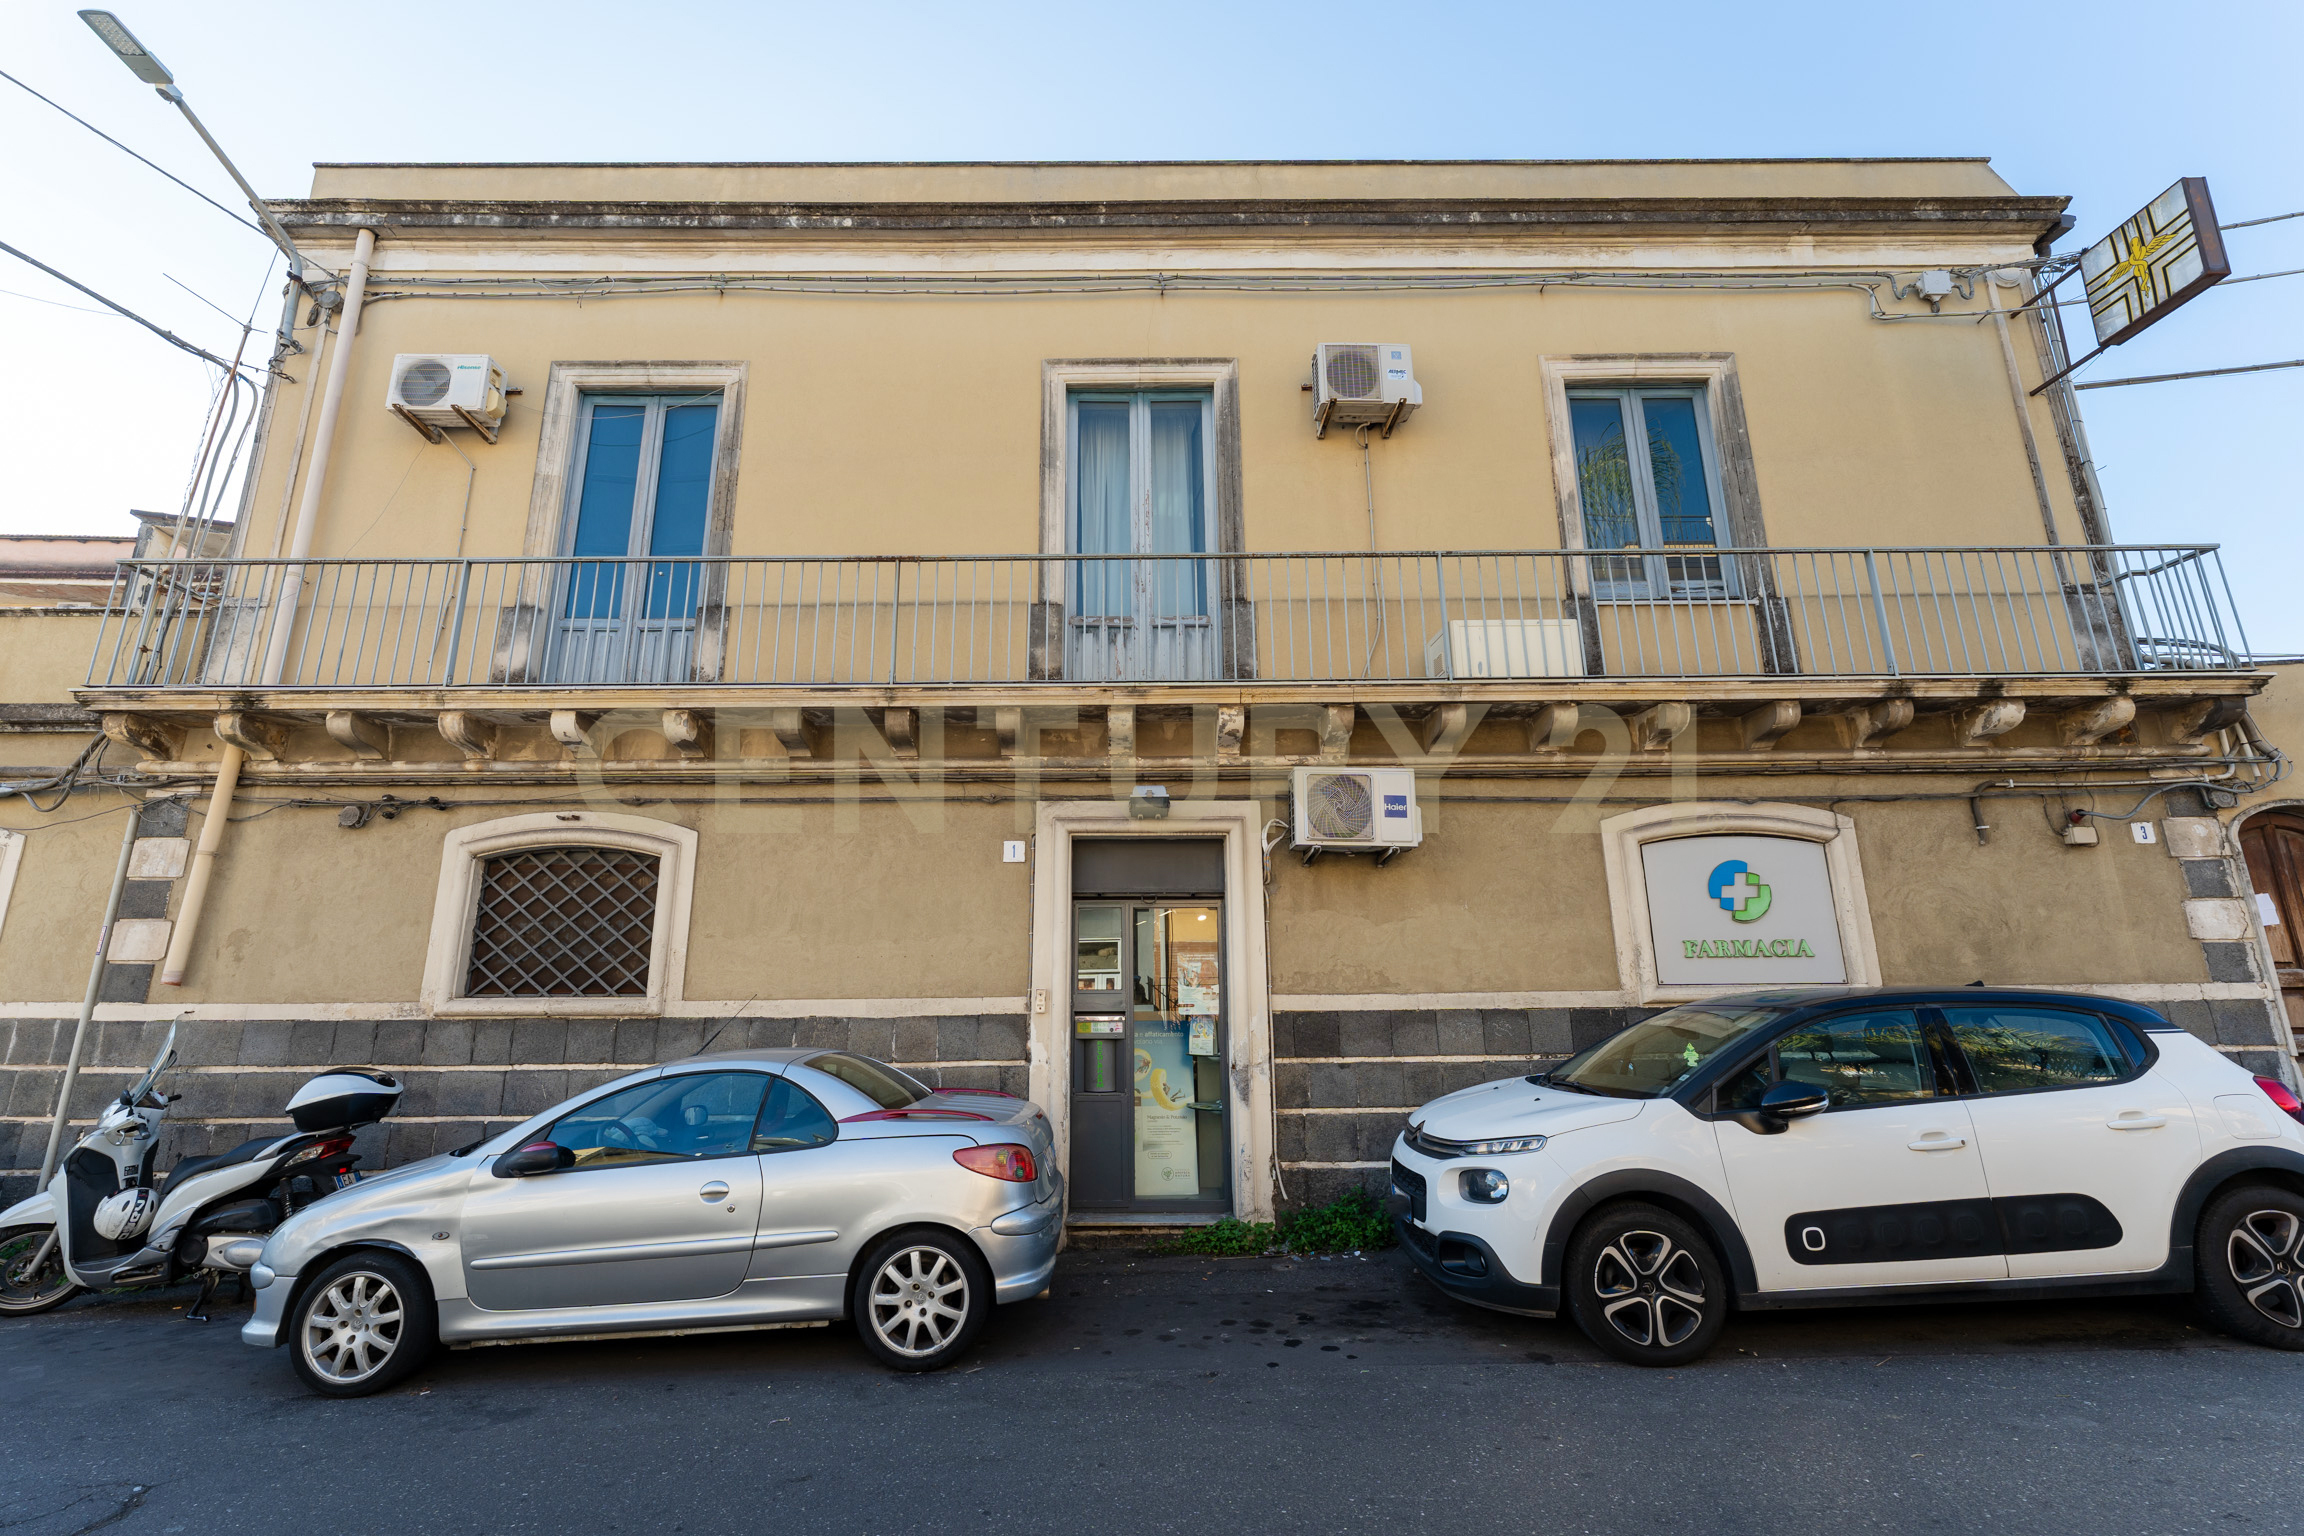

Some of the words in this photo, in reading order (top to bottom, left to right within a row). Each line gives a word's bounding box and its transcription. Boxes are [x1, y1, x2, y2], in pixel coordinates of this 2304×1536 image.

[1384, 803, 1407, 811] Haier
[2140, 825, 2148, 840] 3
[1012, 844, 1016, 859] 1
[1682, 938, 1816, 959] FARMACIA
